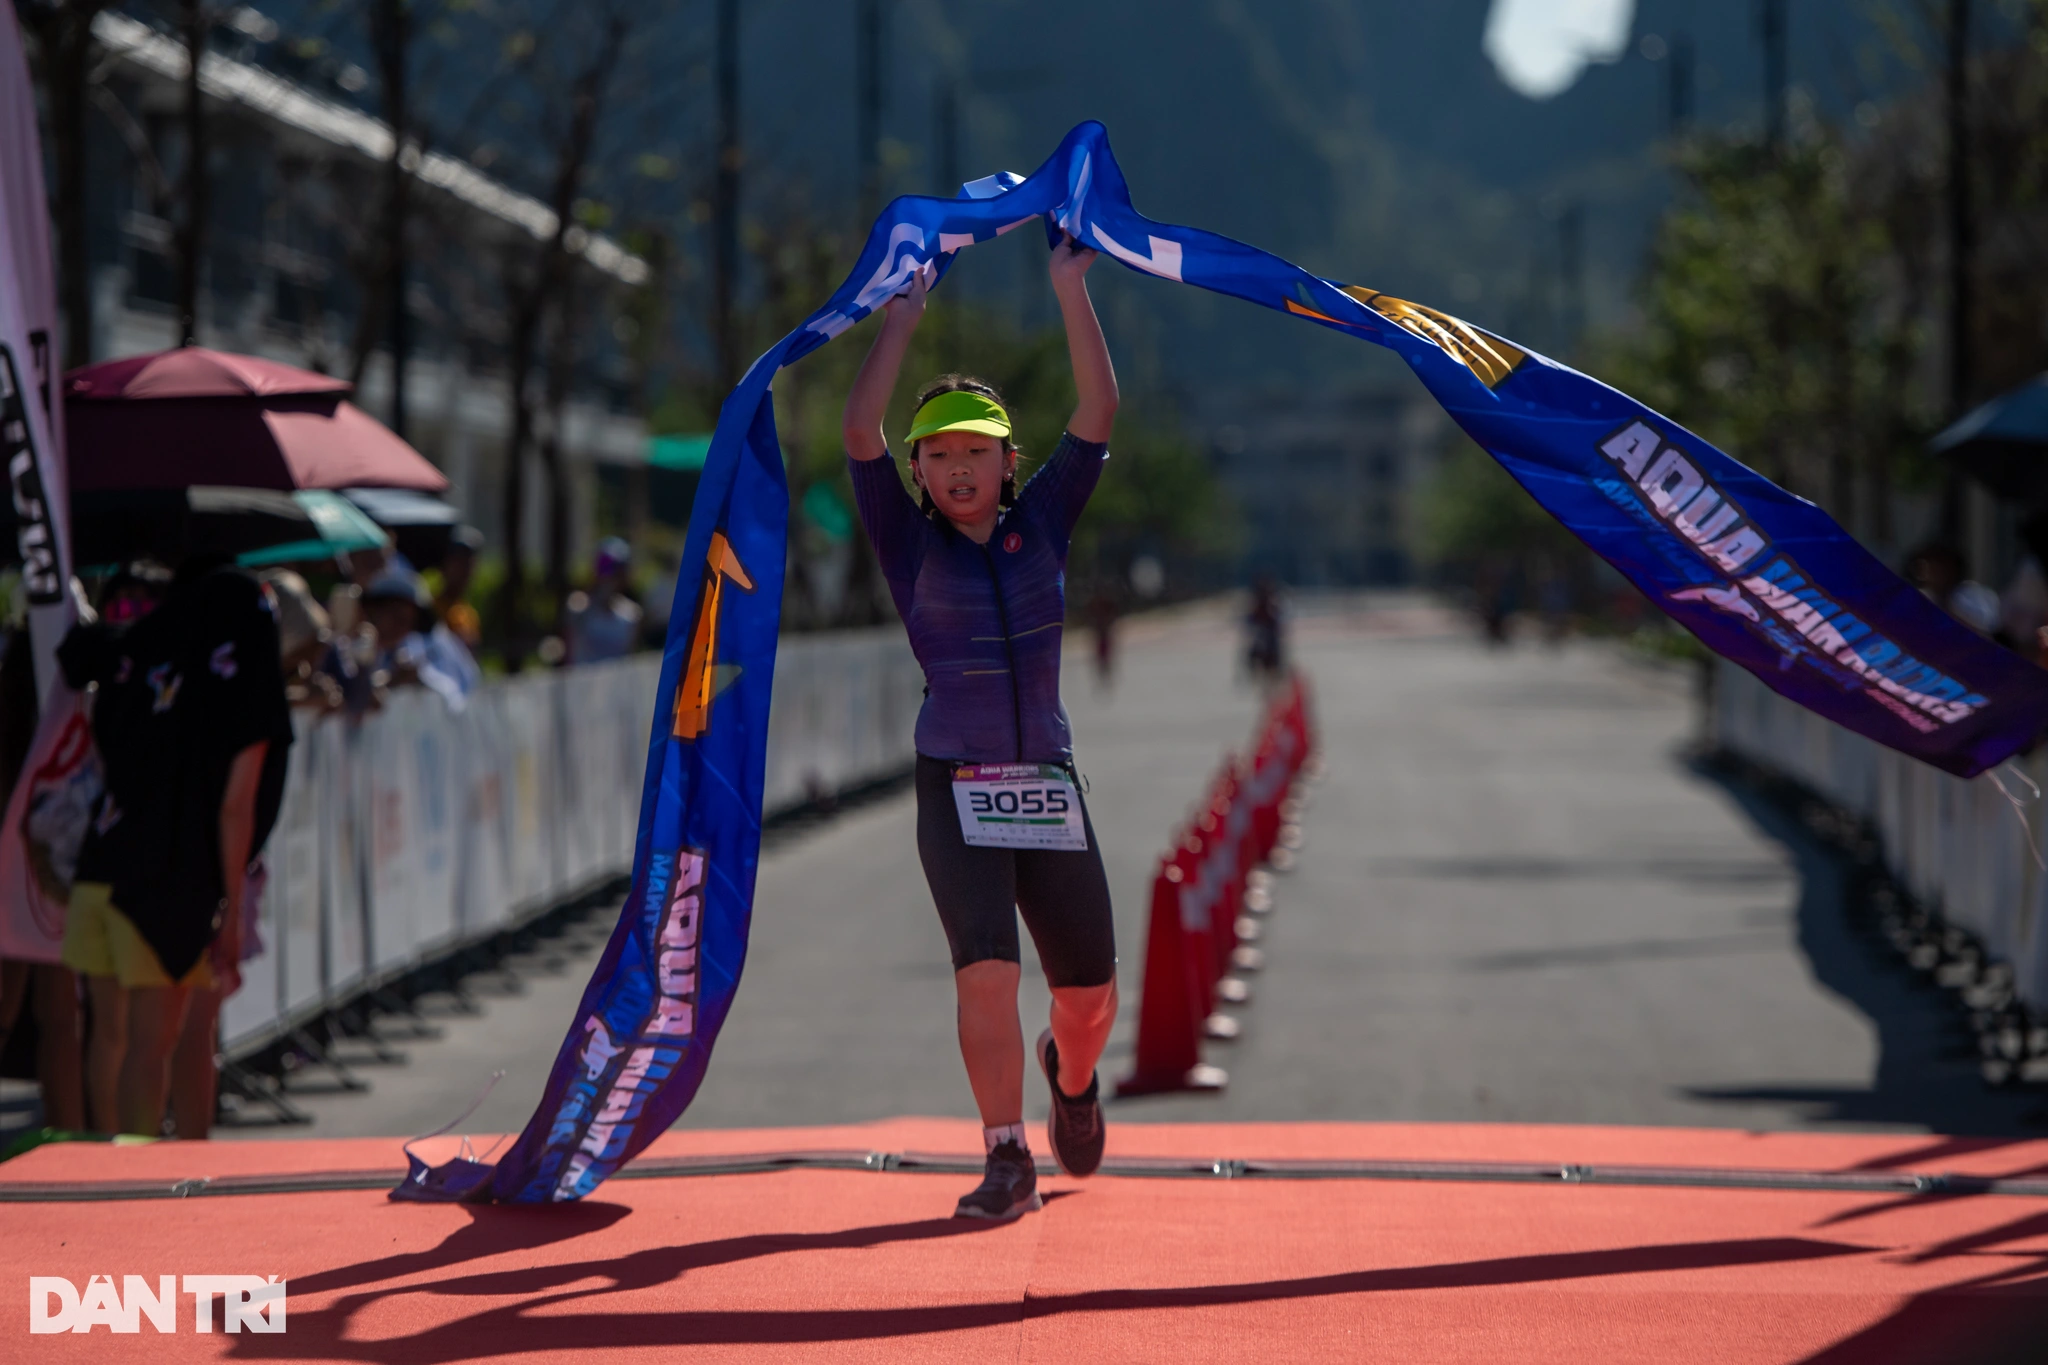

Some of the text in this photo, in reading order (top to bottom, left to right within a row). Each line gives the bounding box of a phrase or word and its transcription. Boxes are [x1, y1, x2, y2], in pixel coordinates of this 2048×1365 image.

[1600, 420, 1768, 573] AQUA
[969, 789, 1069, 814] 3055
[642, 850, 704, 1036] AQUA
